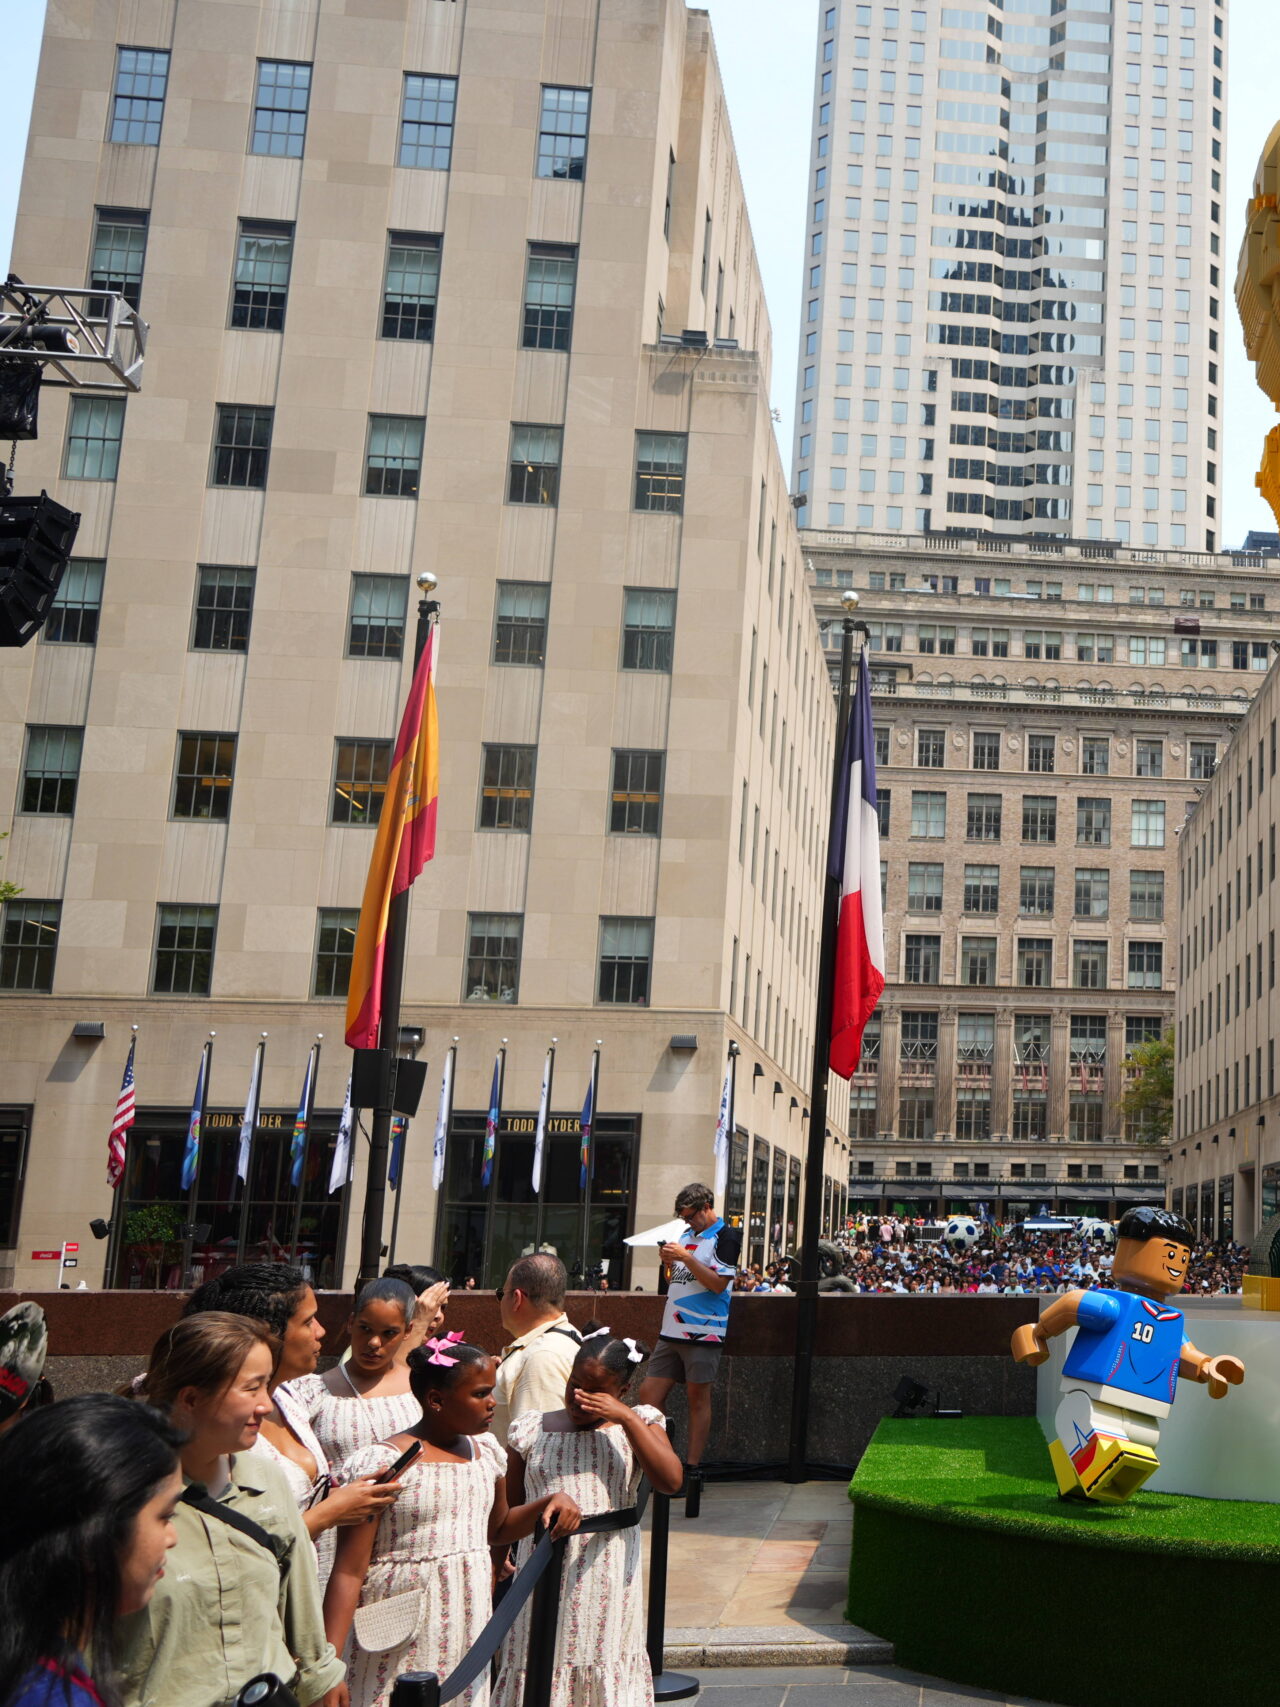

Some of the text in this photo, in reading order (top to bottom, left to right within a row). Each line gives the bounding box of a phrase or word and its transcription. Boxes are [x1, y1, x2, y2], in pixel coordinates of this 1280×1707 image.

[205, 1114, 282, 1129] TODD SDER
[507, 1118, 535, 1132] TODD
[1132, 1321, 1155, 1344] 10
